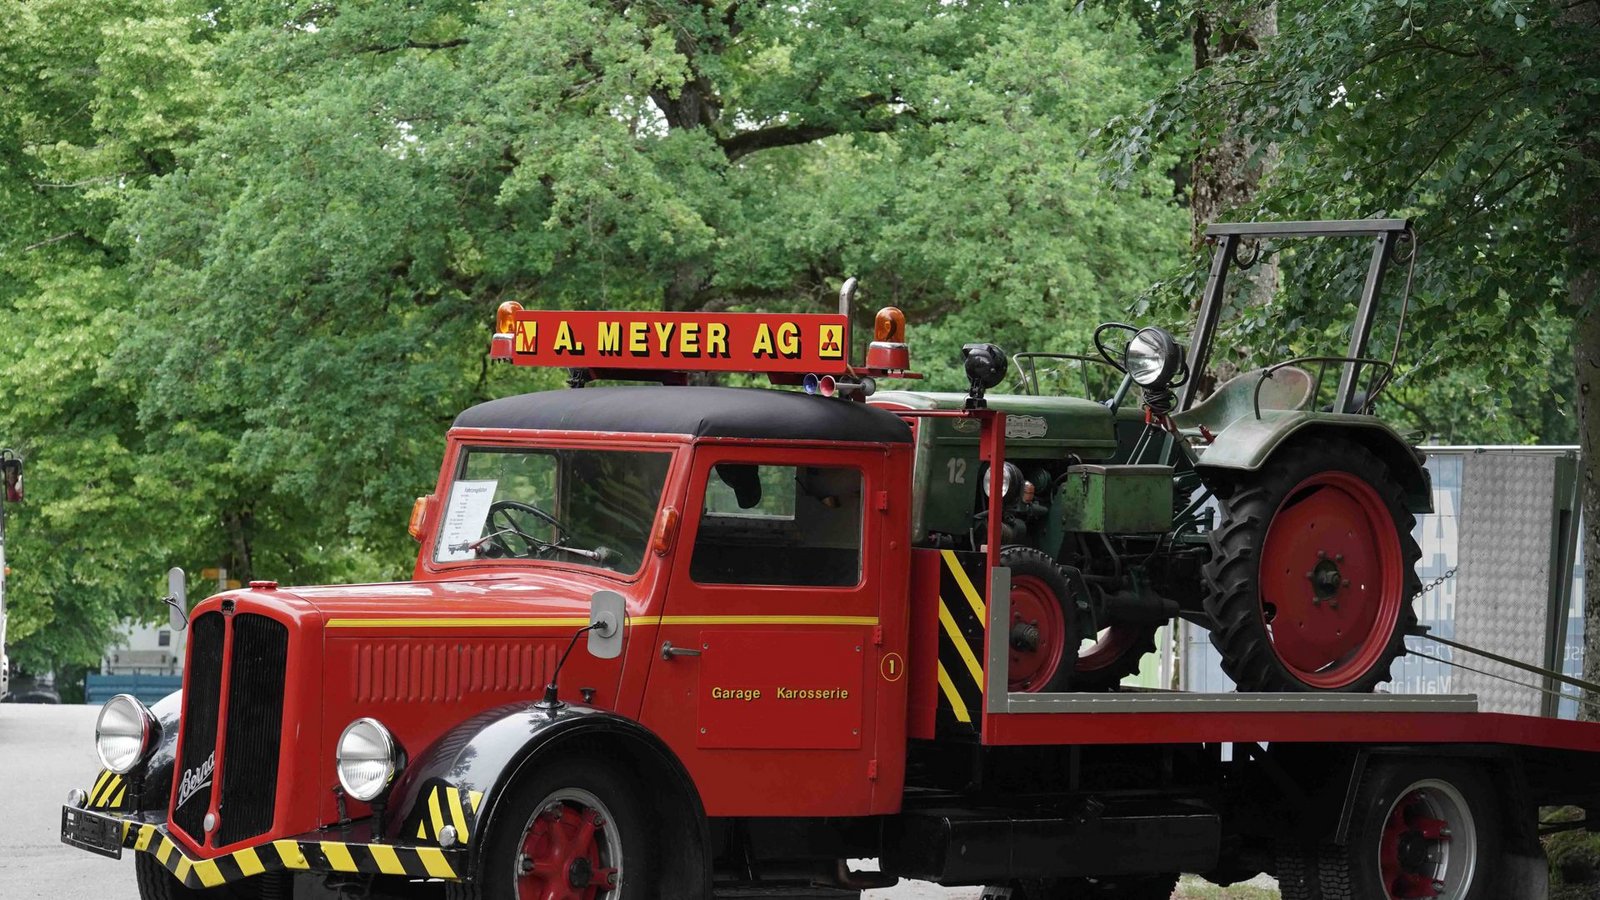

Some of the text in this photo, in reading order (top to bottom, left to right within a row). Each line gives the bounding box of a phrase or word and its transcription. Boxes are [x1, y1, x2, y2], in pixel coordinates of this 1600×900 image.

[553, 320, 801, 359] A. MEYER AG
[947, 458, 967, 484] 12
[888, 659, 895, 674] 1
[711, 686, 849, 701] Garage Karosserie
[177, 750, 216, 807] Berna
